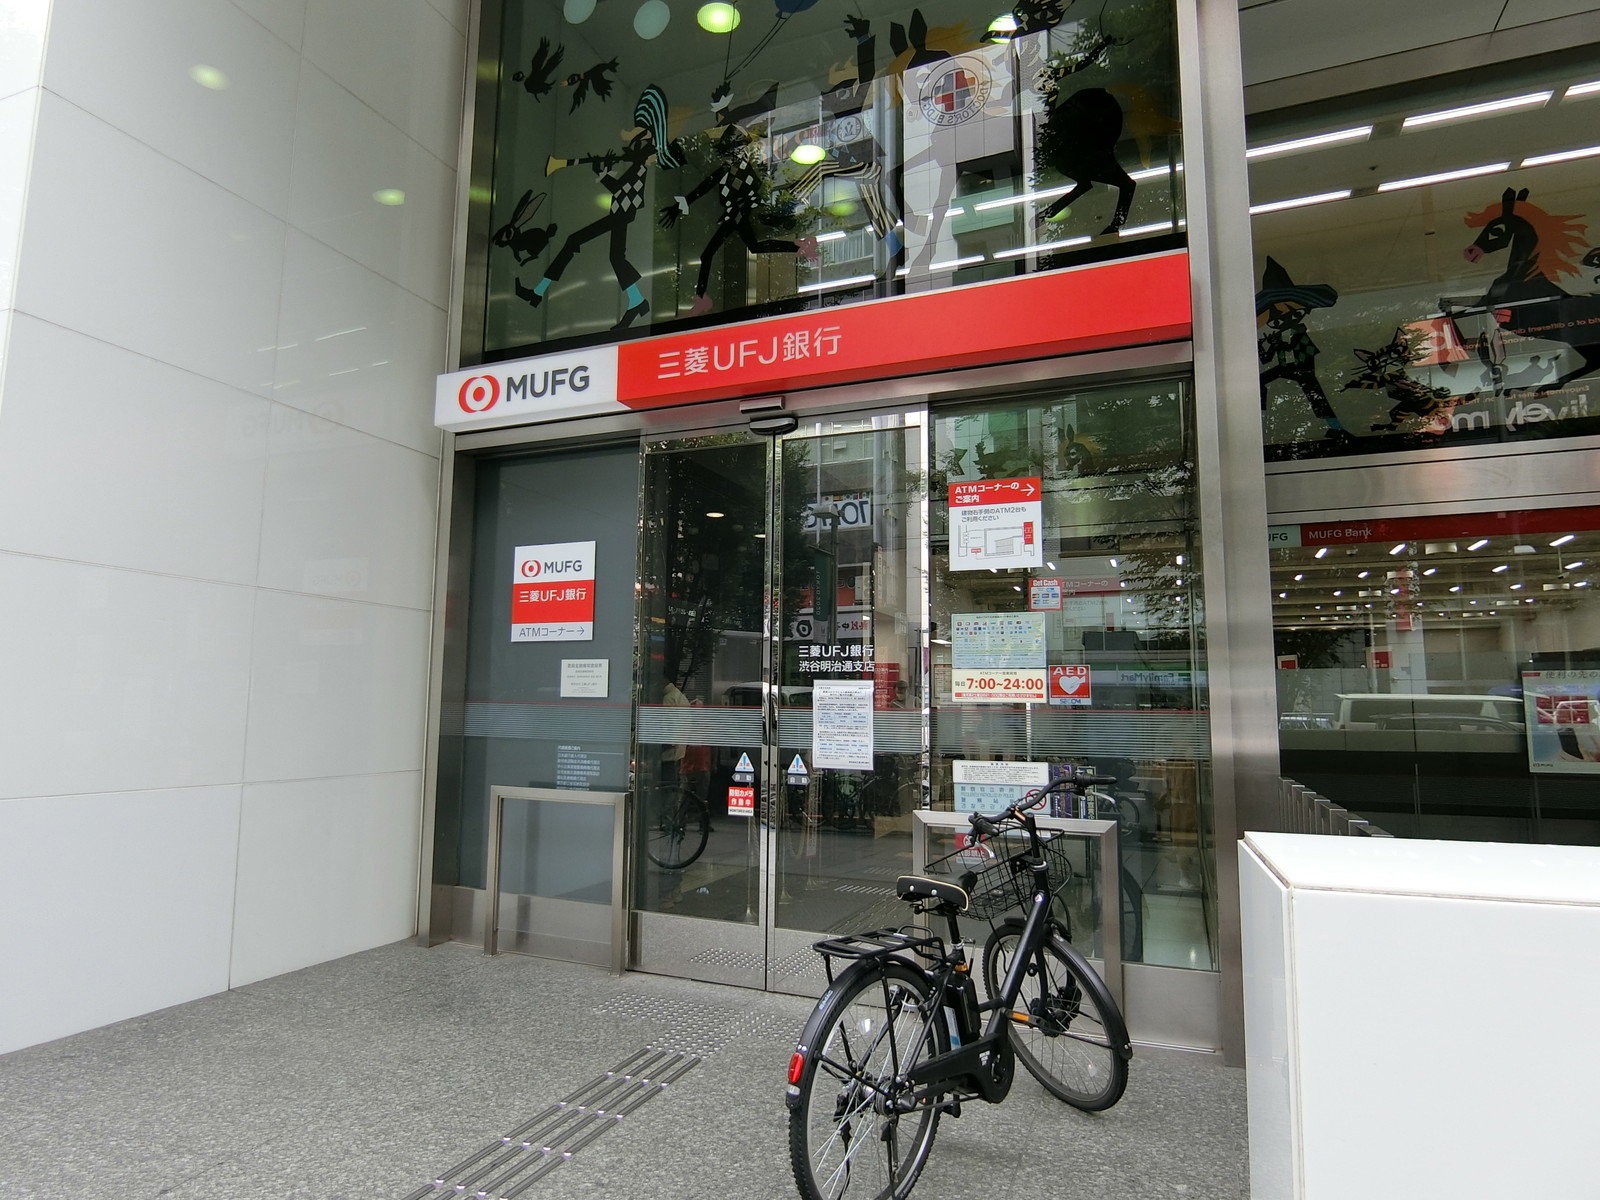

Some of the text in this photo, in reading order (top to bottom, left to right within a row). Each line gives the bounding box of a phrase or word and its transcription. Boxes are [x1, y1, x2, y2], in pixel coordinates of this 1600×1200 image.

[657, 325, 843, 380] 三菱UFJ銀行
[506, 365, 591, 402] MUFG
[954, 481, 1020, 494] ATMコーナーの
[955, 494, 980, 504] ご案内
[1309, 527, 1372, 540] MUFG Bank
[544, 559, 582, 574] MUFG
[519, 587, 587, 602] 三菱UFJ銀行
[519, 626, 575, 638] ATMコーナー
[798, 644, 875, 659] 三菱UFJ銀行
[798, 659, 875, 673] 渋谷明治通支店
[1053, 666, 1087, 675] AED
[1545, 671, 1600, 679] 便利の先の
